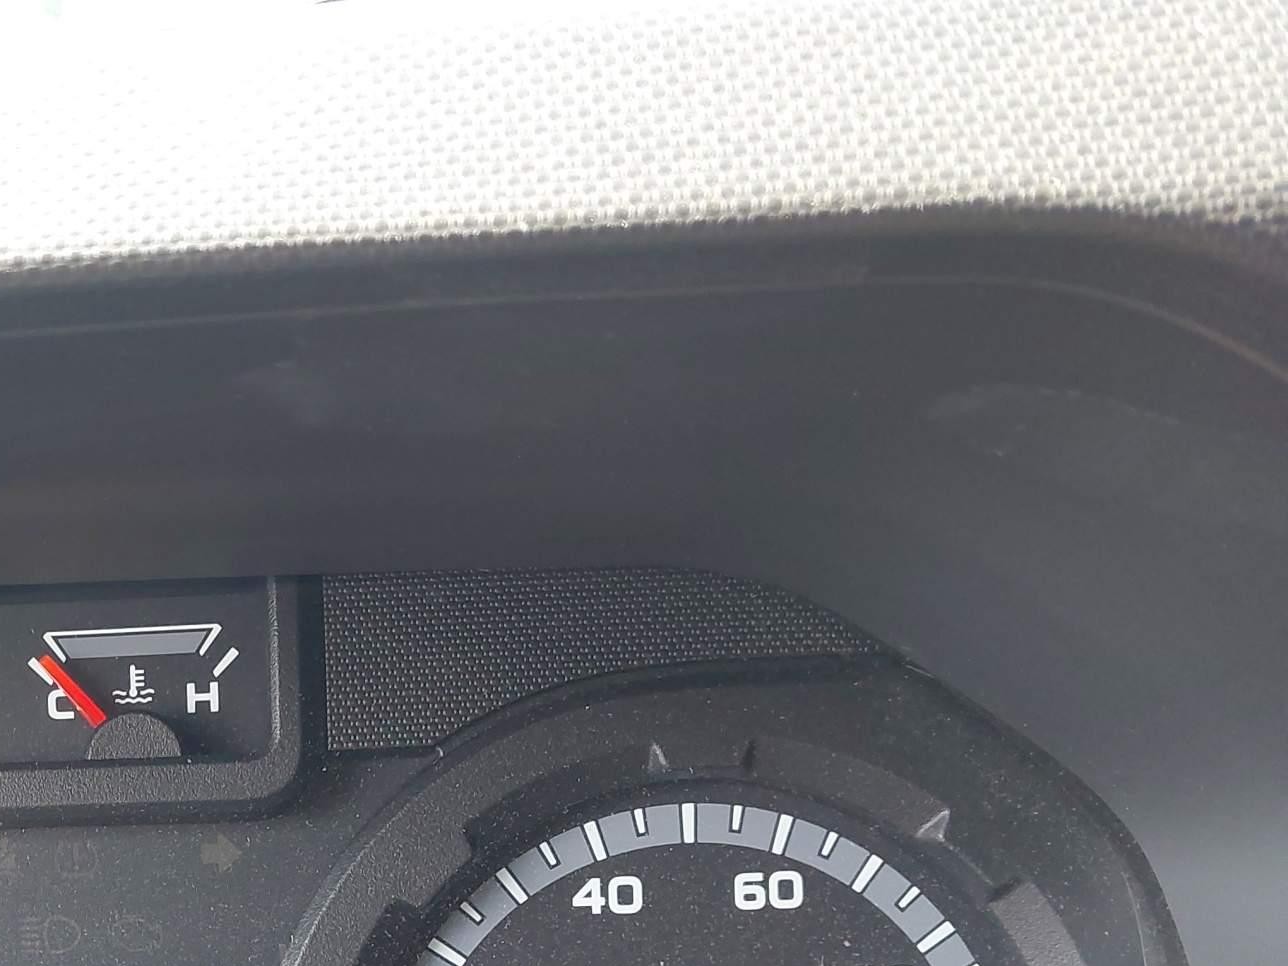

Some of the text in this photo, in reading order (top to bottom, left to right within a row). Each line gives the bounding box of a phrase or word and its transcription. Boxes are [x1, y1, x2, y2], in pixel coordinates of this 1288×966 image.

[187, 682, 219, 714] H
[572, 875, 643, 915] 40
[734, 870, 804, 911] 60
